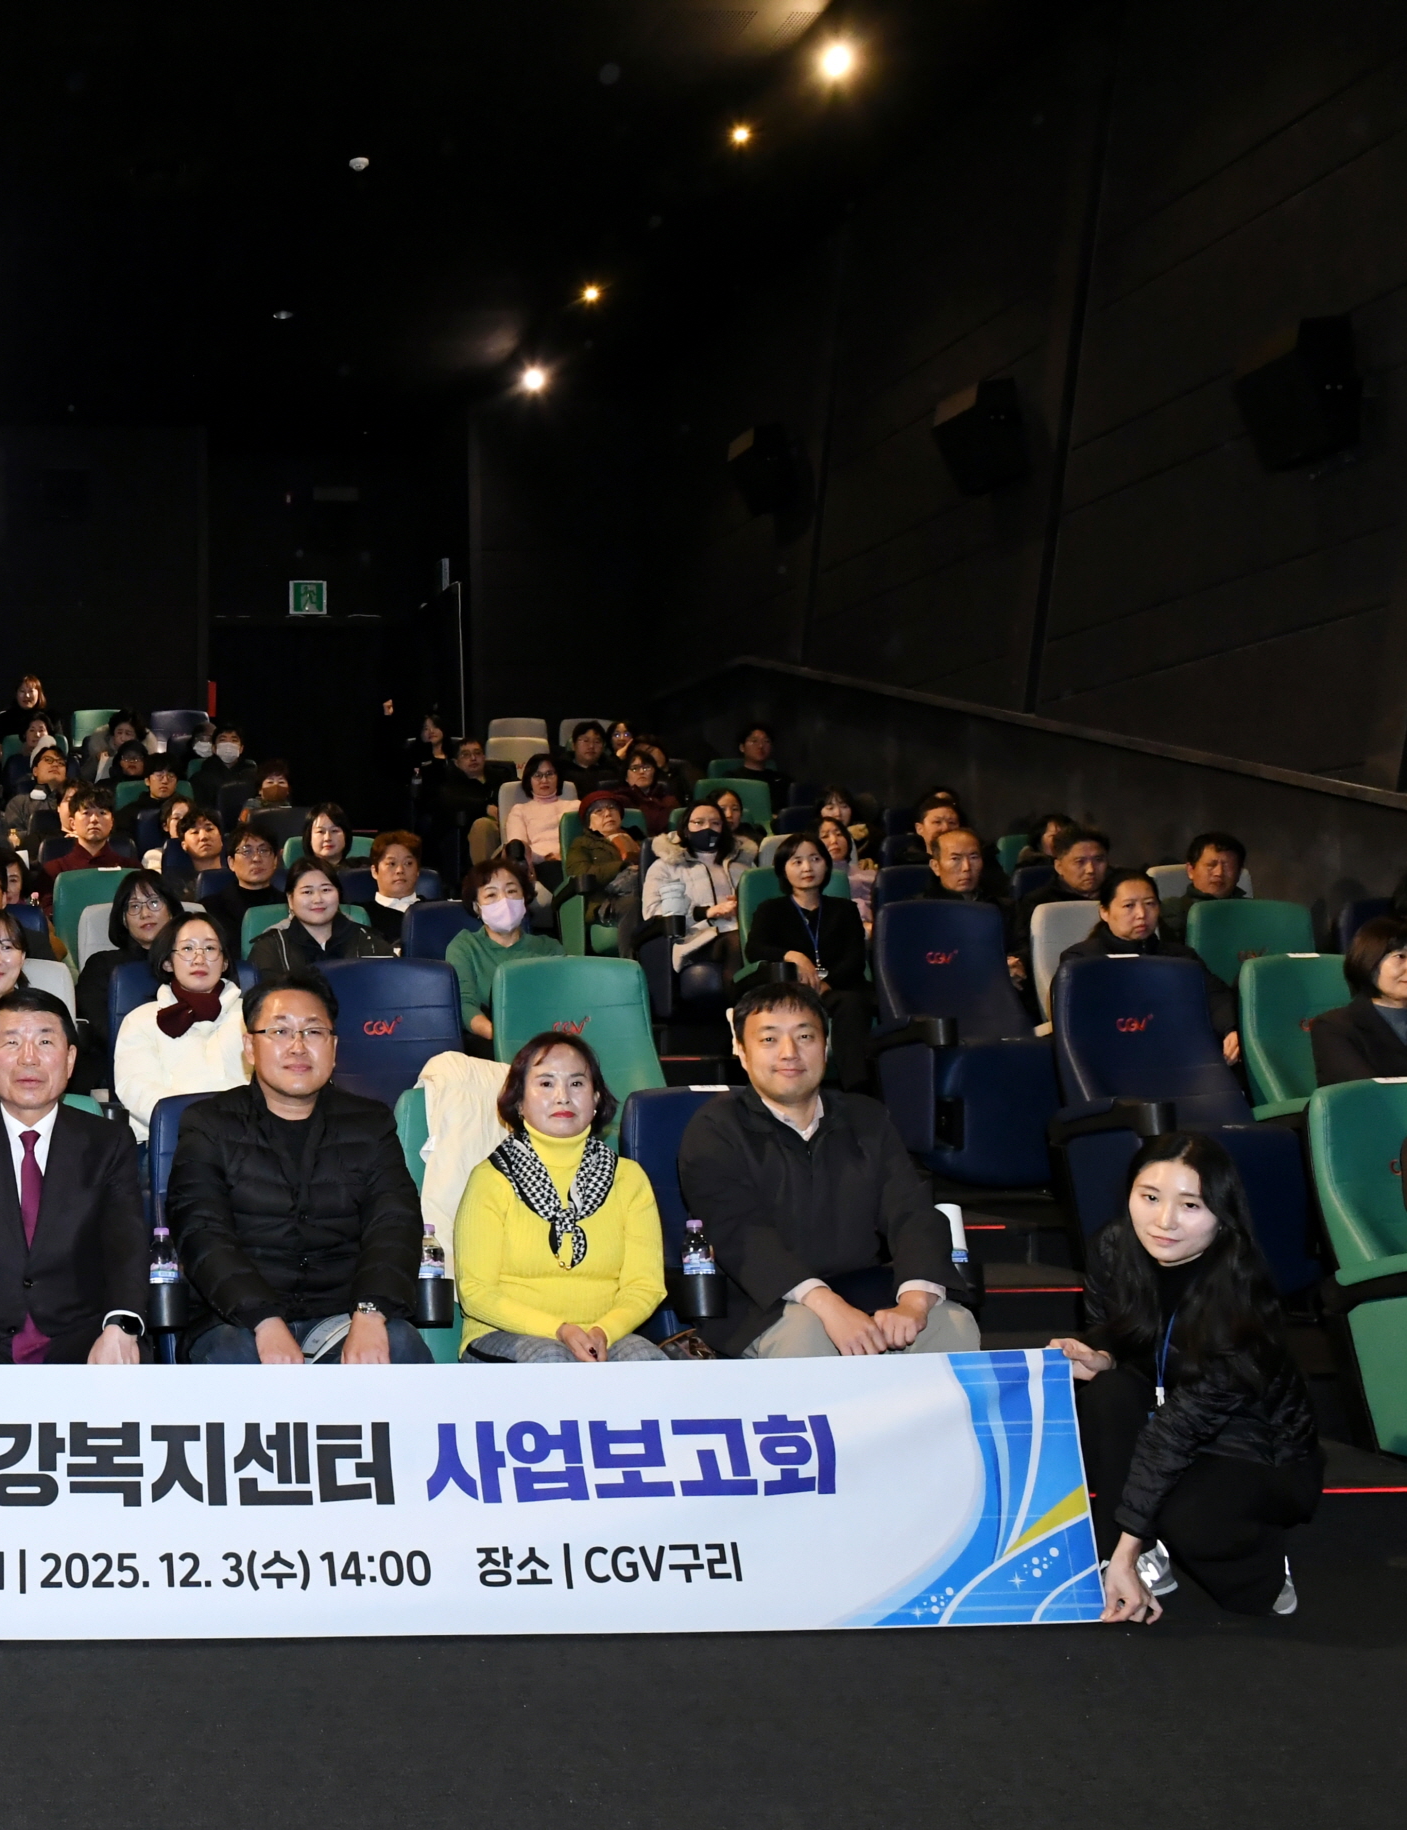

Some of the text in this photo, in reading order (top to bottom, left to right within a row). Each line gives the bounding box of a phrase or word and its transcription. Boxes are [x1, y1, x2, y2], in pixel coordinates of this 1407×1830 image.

[926, 952, 953, 964] CGV
[363, 1020, 396, 1035] CGV
[1116, 1017, 1148, 1032] CGV
[426, 1414, 837, 1504] 사업보고회
[40, 1552, 150, 1589] 2025.
[158, 1552, 212, 1588] 12.
[221, 1549, 311, 1592] 3(수)
[319, 1550, 432, 1587] 14:00
[476, 1546, 553, 1588] 장소
[584, 1541, 743, 1584] CGV구리
